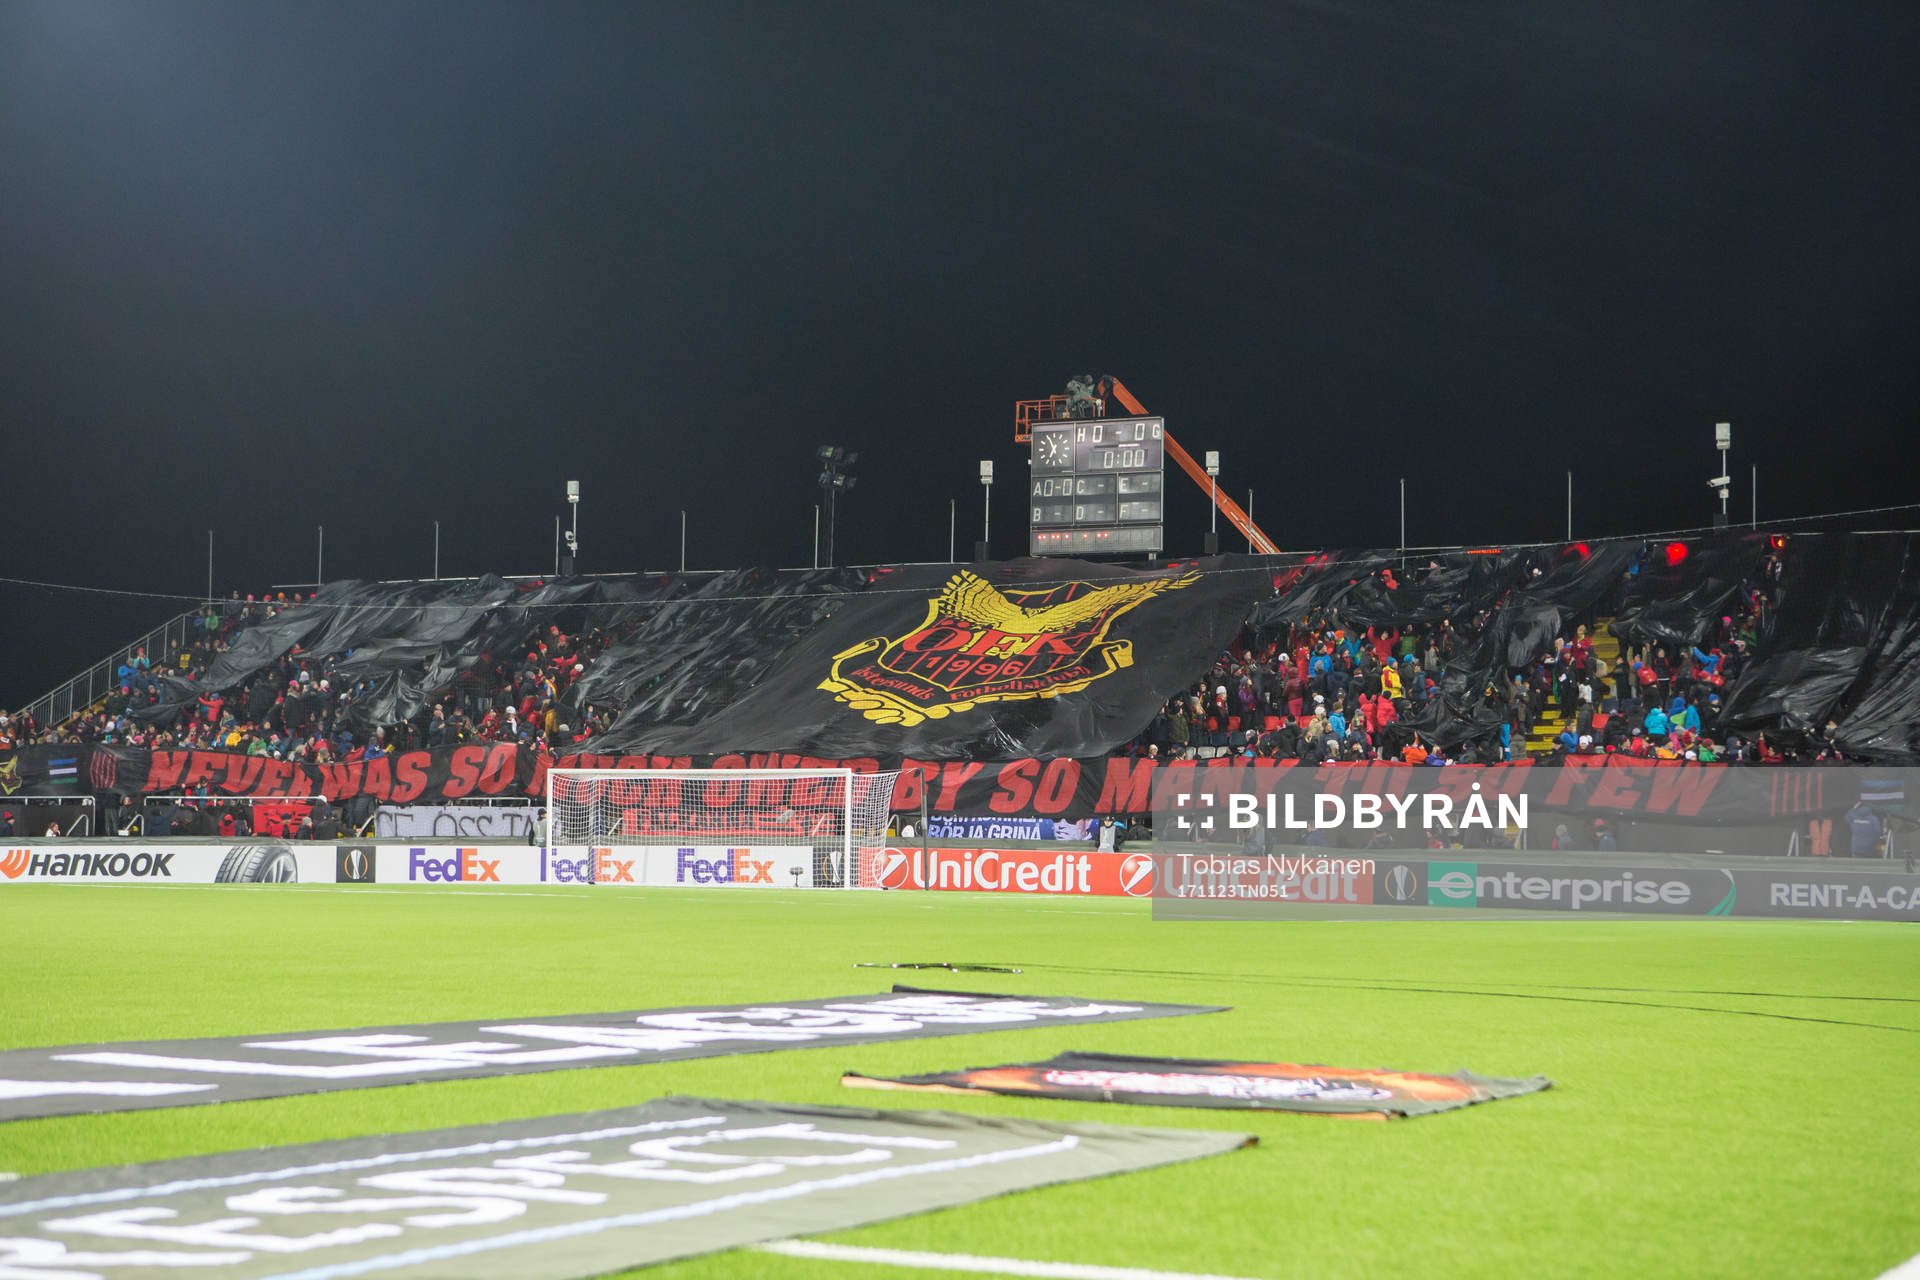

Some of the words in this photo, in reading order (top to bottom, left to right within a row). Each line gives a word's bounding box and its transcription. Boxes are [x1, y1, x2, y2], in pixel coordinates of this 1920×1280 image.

[925, 656, 1024, 676] 1996
[142, 751, 313, 804] NEVER
[318, 751, 431, 803] WAS
[442, 742, 518, 798] SO
[890, 757, 984, 811] BY
[988, 757, 1082, 814] SO
[1094, 757, 1300, 813] MANY
[1545, 753, 1729, 816] FEW
[408, 847, 501, 882] FedEx
[676, 848, 775, 884] FedEx
[913, 851, 1092, 893] UniCredit
[1428, 871, 1692, 910] enterprise
